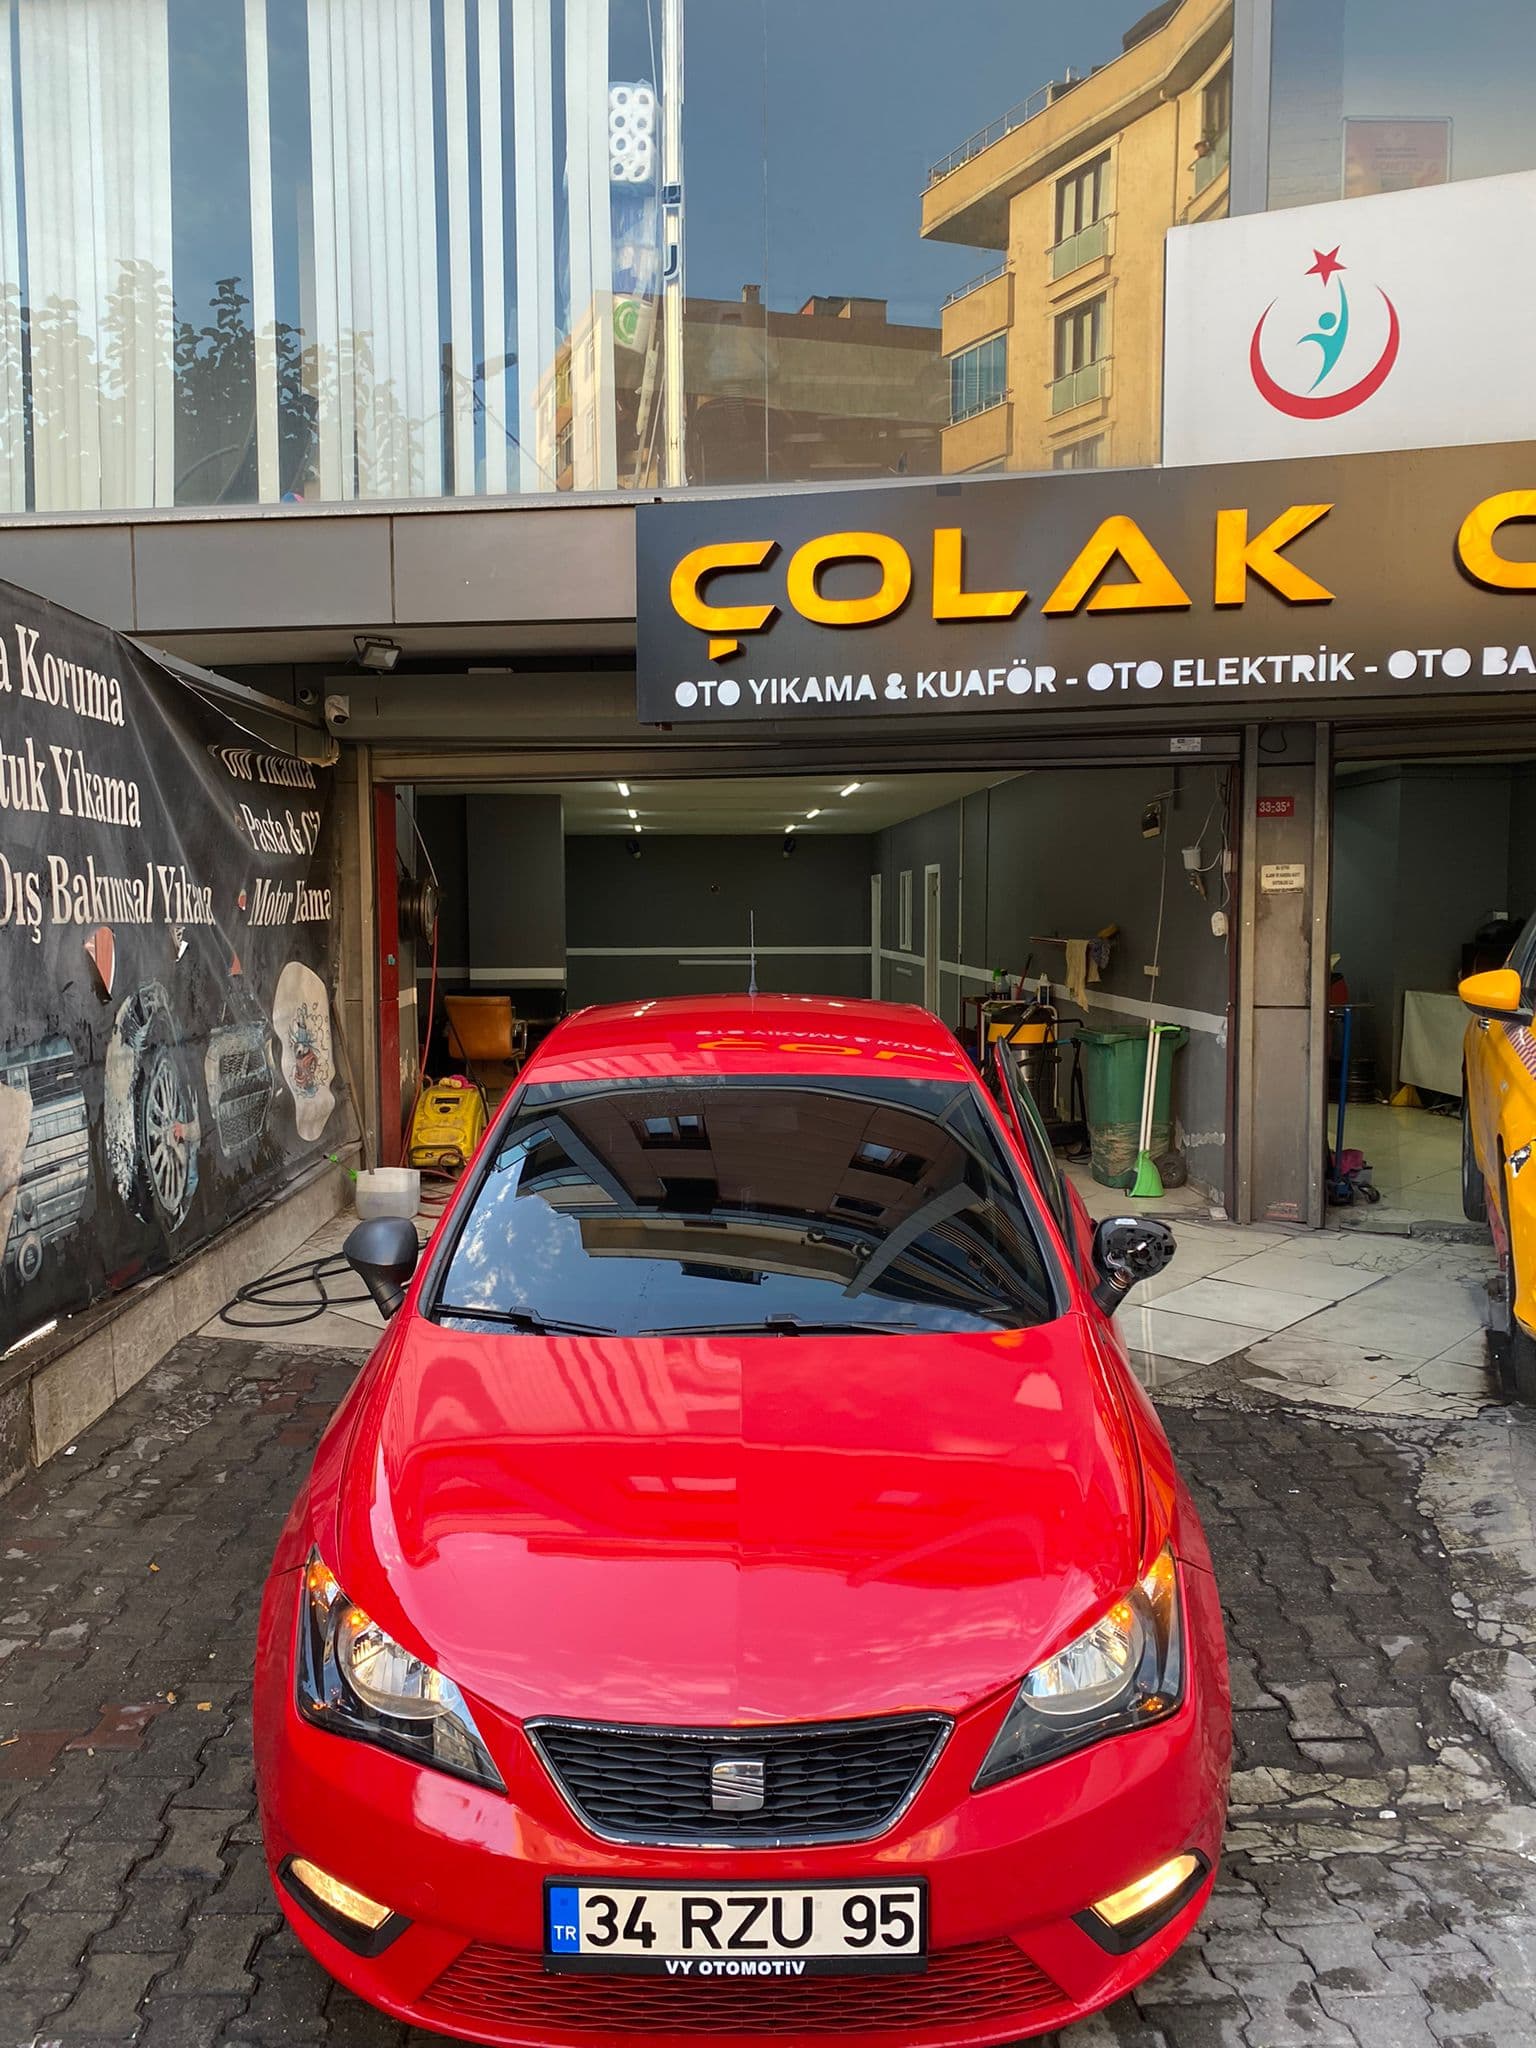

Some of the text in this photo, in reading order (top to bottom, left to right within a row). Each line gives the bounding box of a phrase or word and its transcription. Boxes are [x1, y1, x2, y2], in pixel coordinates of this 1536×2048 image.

[669, 503, 1334, 661] ÇOLAK
[15, 623, 125, 727] Koruma
[675, 680, 741, 708] OTO
[749, 675, 877, 705] YIKAMA
[885, 672, 908, 700] &
[917, 658, 1057, 699] KUAFÖR
[1087, 660, 1164, 691] OTO
[1174, 645, 1355, 687] ELEKTRİK
[1388, 647, 1472, 679] OTO
[49, 745, 141, 828] Yıkama
[239, 803, 291, 855] Pasta
[286, 810, 306, 855] &
[247, 877, 294, 927] Motor
[553, 1925, 577, 1940] TR
[585, 1893, 915, 1950] 34 RZU 95
[665, 1960, 694, 1975] VY
